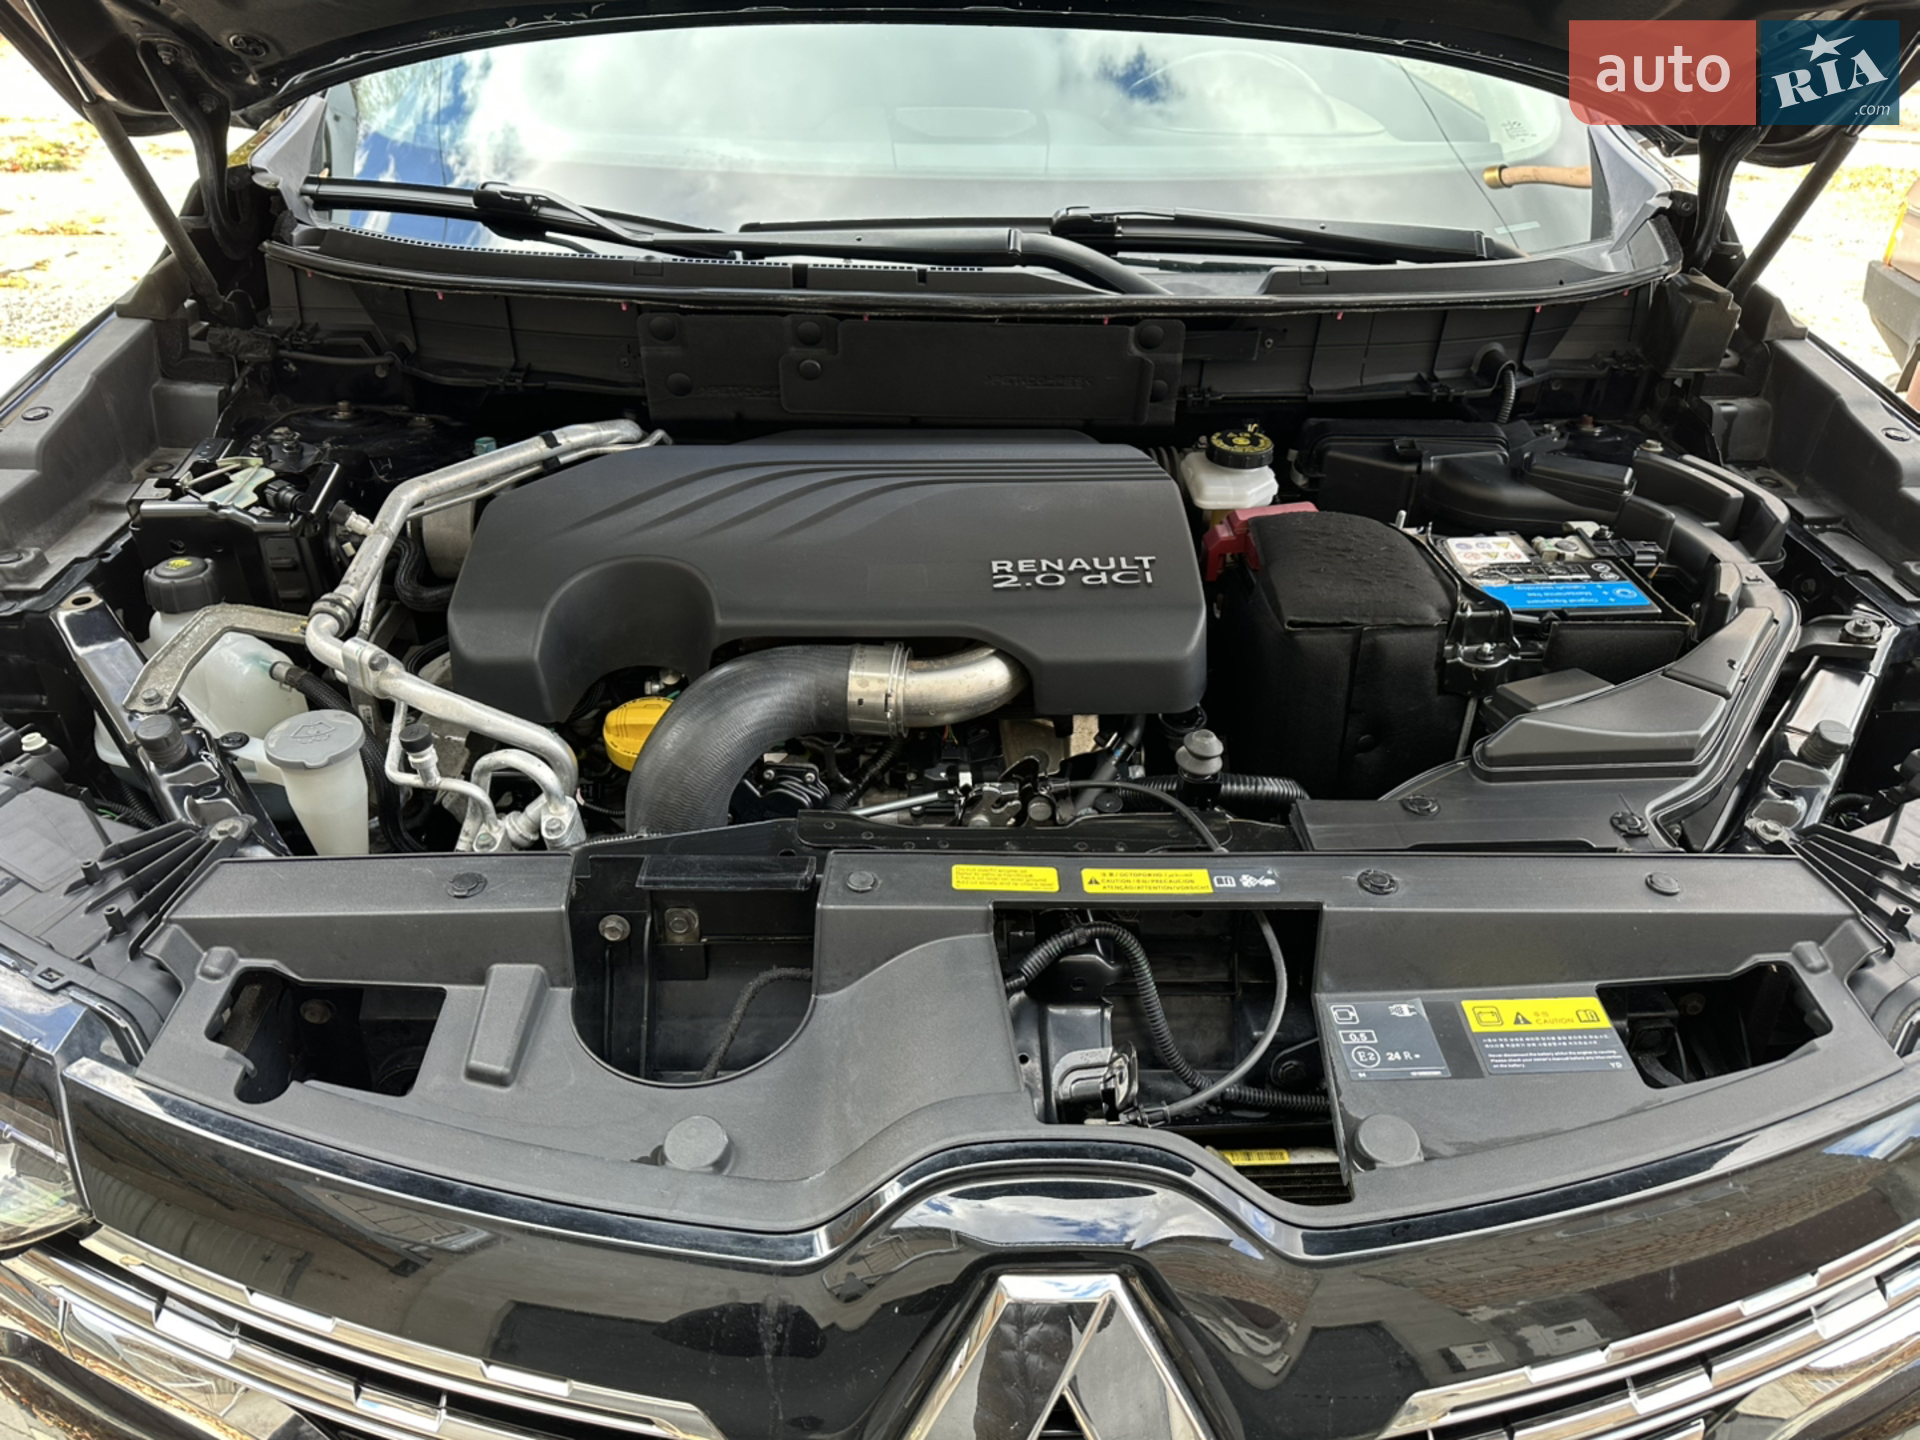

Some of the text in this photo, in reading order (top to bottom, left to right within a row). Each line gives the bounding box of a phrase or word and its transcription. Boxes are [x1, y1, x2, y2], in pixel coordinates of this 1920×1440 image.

[991, 556, 1156, 573] RENAULT
[992, 573, 1066, 588] 2.0
[1535, 1017, 1575, 1025] CAUTION
[1348, 1033, 1368, 1042] 0.5
